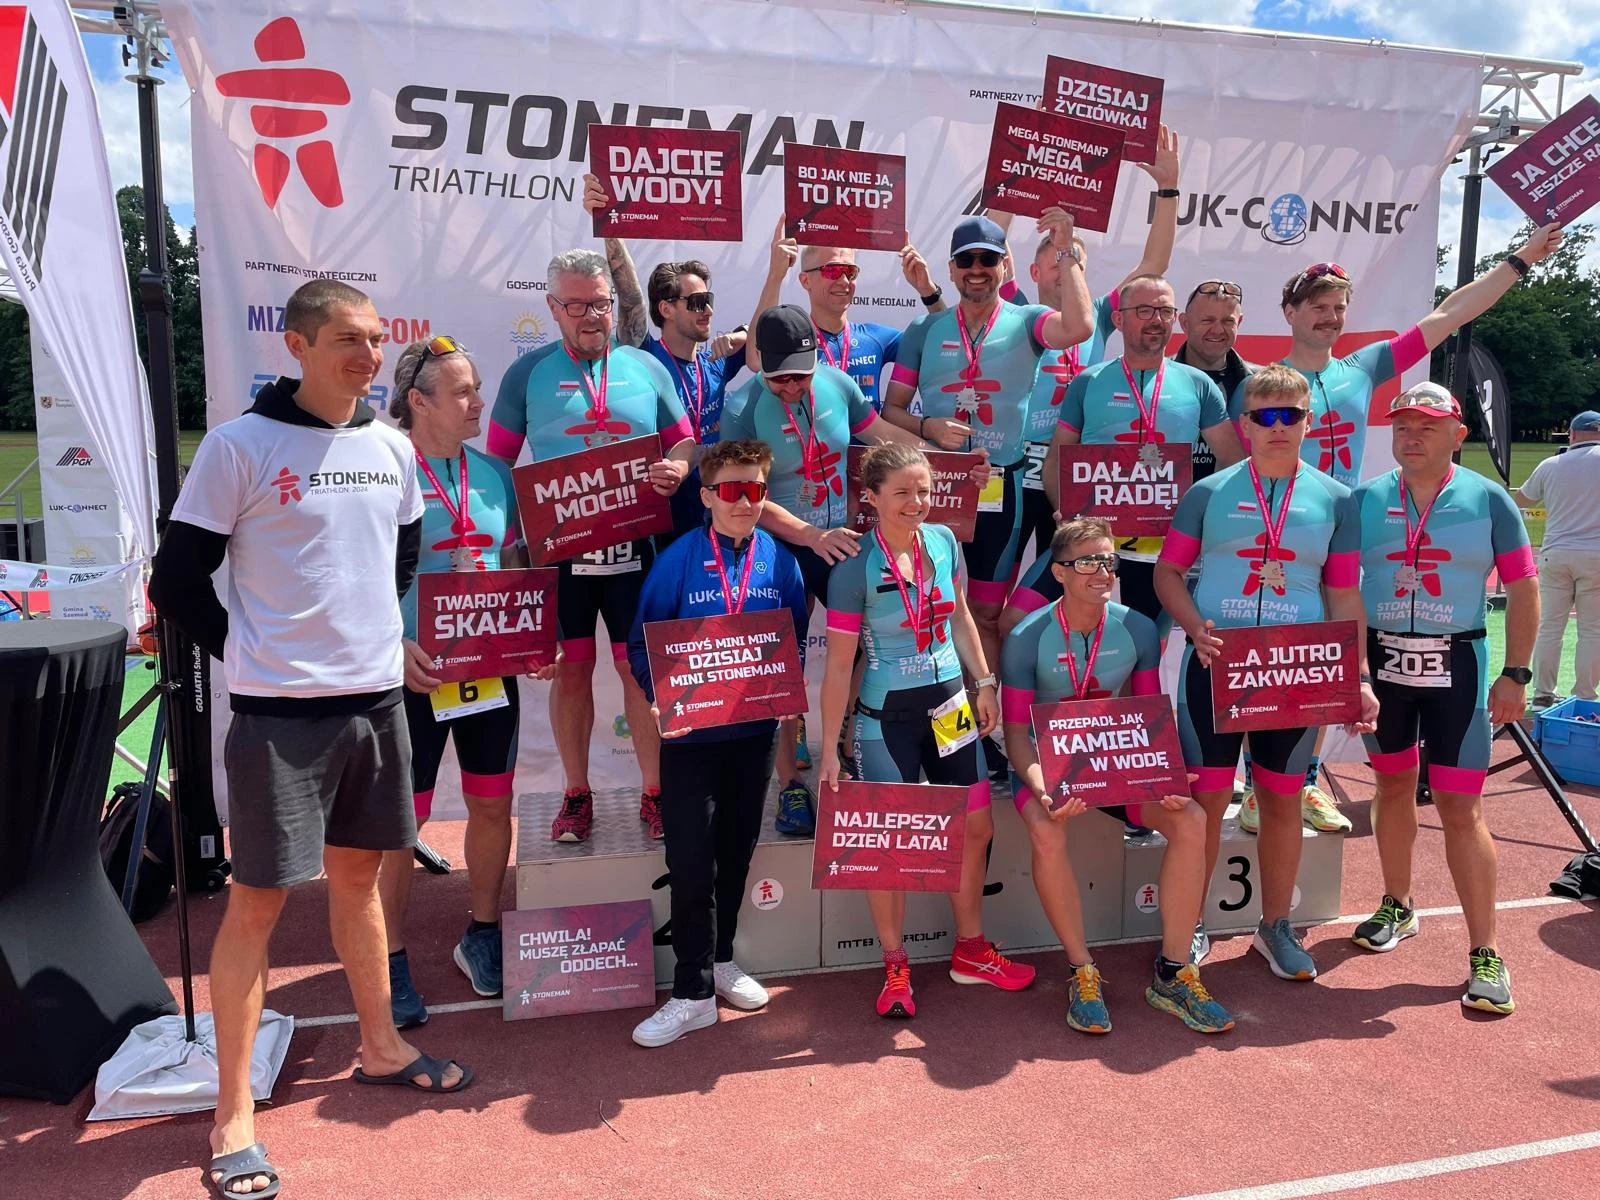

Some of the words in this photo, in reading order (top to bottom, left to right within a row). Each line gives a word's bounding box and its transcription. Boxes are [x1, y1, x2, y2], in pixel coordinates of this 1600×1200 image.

[970, 89, 1024, 102] PARTNERZY
[1057, 76, 1149, 112] DZISIAJ
[1054, 96, 1147, 130] ŻYCIÓWKA!
[391, 84, 866, 176] STONA
[1007, 125, 1041, 142] MEGA
[1042, 133, 1109, 158] STONEMAN?
[608, 145, 724, 177] DAJCIE
[1026, 143, 1084, 173] MEGA
[388, 164, 576, 202] TRIATHLON
[798, 166, 818, 180] BO
[820, 168, 846, 183] JAK
[848, 171, 872, 185] NIE
[874, 173, 893, 188] JA,
[1001, 159, 1103, 193] SATYSFAKCJA!
[1511, 162, 1547, 190] JA
[1528, 157, 1586, 202] JESZCZE
[609, 175, 722, 205] WODY!
[798, 182, 829, 204] TO
[836, 187, 893, 209] KTO?
[620, 213, 659, 221] STONEMAN
[808, 222, 839, 231] STONEMAN
[302, 269, 378, 283] STRATEGICZNI
[871, 298, 917, 308] MEDIALNI
[308, 471, 400, 487] STONEMAN
[533, 467, 606, 505] MAM
[612, 457, 650, 483] TĘ
[1072, 461, 1174, 483] DAŁAM
[310, 486, 349, 496] TRIATHLON
[1094, 483, 1179, 510] RADĘ!
[554, 484, 638, 524] MOC!!!
[555, 529, 593, 544] STONEMAN
[583, 541, 632, 564] 419
[433, 592, 510, 612] TWARDY
[514, 590, 544, 606] JAK
[1221, 598, 1299, 614] STONEMAN
[1376, 600, 1454, 614] STONEMAN
[434, 608, 543, 640] SKAŁA!
[665, 639, 713, 655] KIEDYŚ
[715, 635, 745, 649] MINI
[748, 632, 780, 645] MINI,
[1268, 642, 1342, 666] JUTRO
[446, 655, 482, 665] STONEMAN
[688, 646, 763, 670] DZISIAJ
[1384, 649, 1444, 677] 203
[670, 672, 704, 688] MINI
[707, 662, 786, 683] STONEMAN!
[1228, 665, 1344, 690] ZAKWASY!
[194, 671, 205, 713] GOLIATH
[458, 680, 479, 703] 6
[686, 699, 724, 711] STONEMAN
[1241, 705, 1278, 714] STONEMAN
[956, 710, 971, 732] 4
[1049, 716, 1118, 731] PRZEPADŁ
[1120, 713, 1144, 725] JAK
[1052, 724, 1149, 755] KAMIEŃ
[1090, 757, 1108, 772] W
[1112, 751, 1169, 769] WODĘ
[1071, 781, 1107, 790] STONEMAN
[834, 811, 951, 831] NAJLEPSZY
[832, 830, 890, 849] DZIEŃ
[896, 835, 948, 851] LATA!
[1219, 855, 1253, 912] 3
[519, 928, 591, 947] CHWILA!
[519, 945, 569, 961] MUSZĘ
[571, 937, 626, 956] ZŁAPAĆ
[837, 937, 874, 949] MTB
[901, 931, 948, 944] ROUP
[560, 954, 638, 974] ODDECH...
[532, 989, 571, 999] STONEMAN
